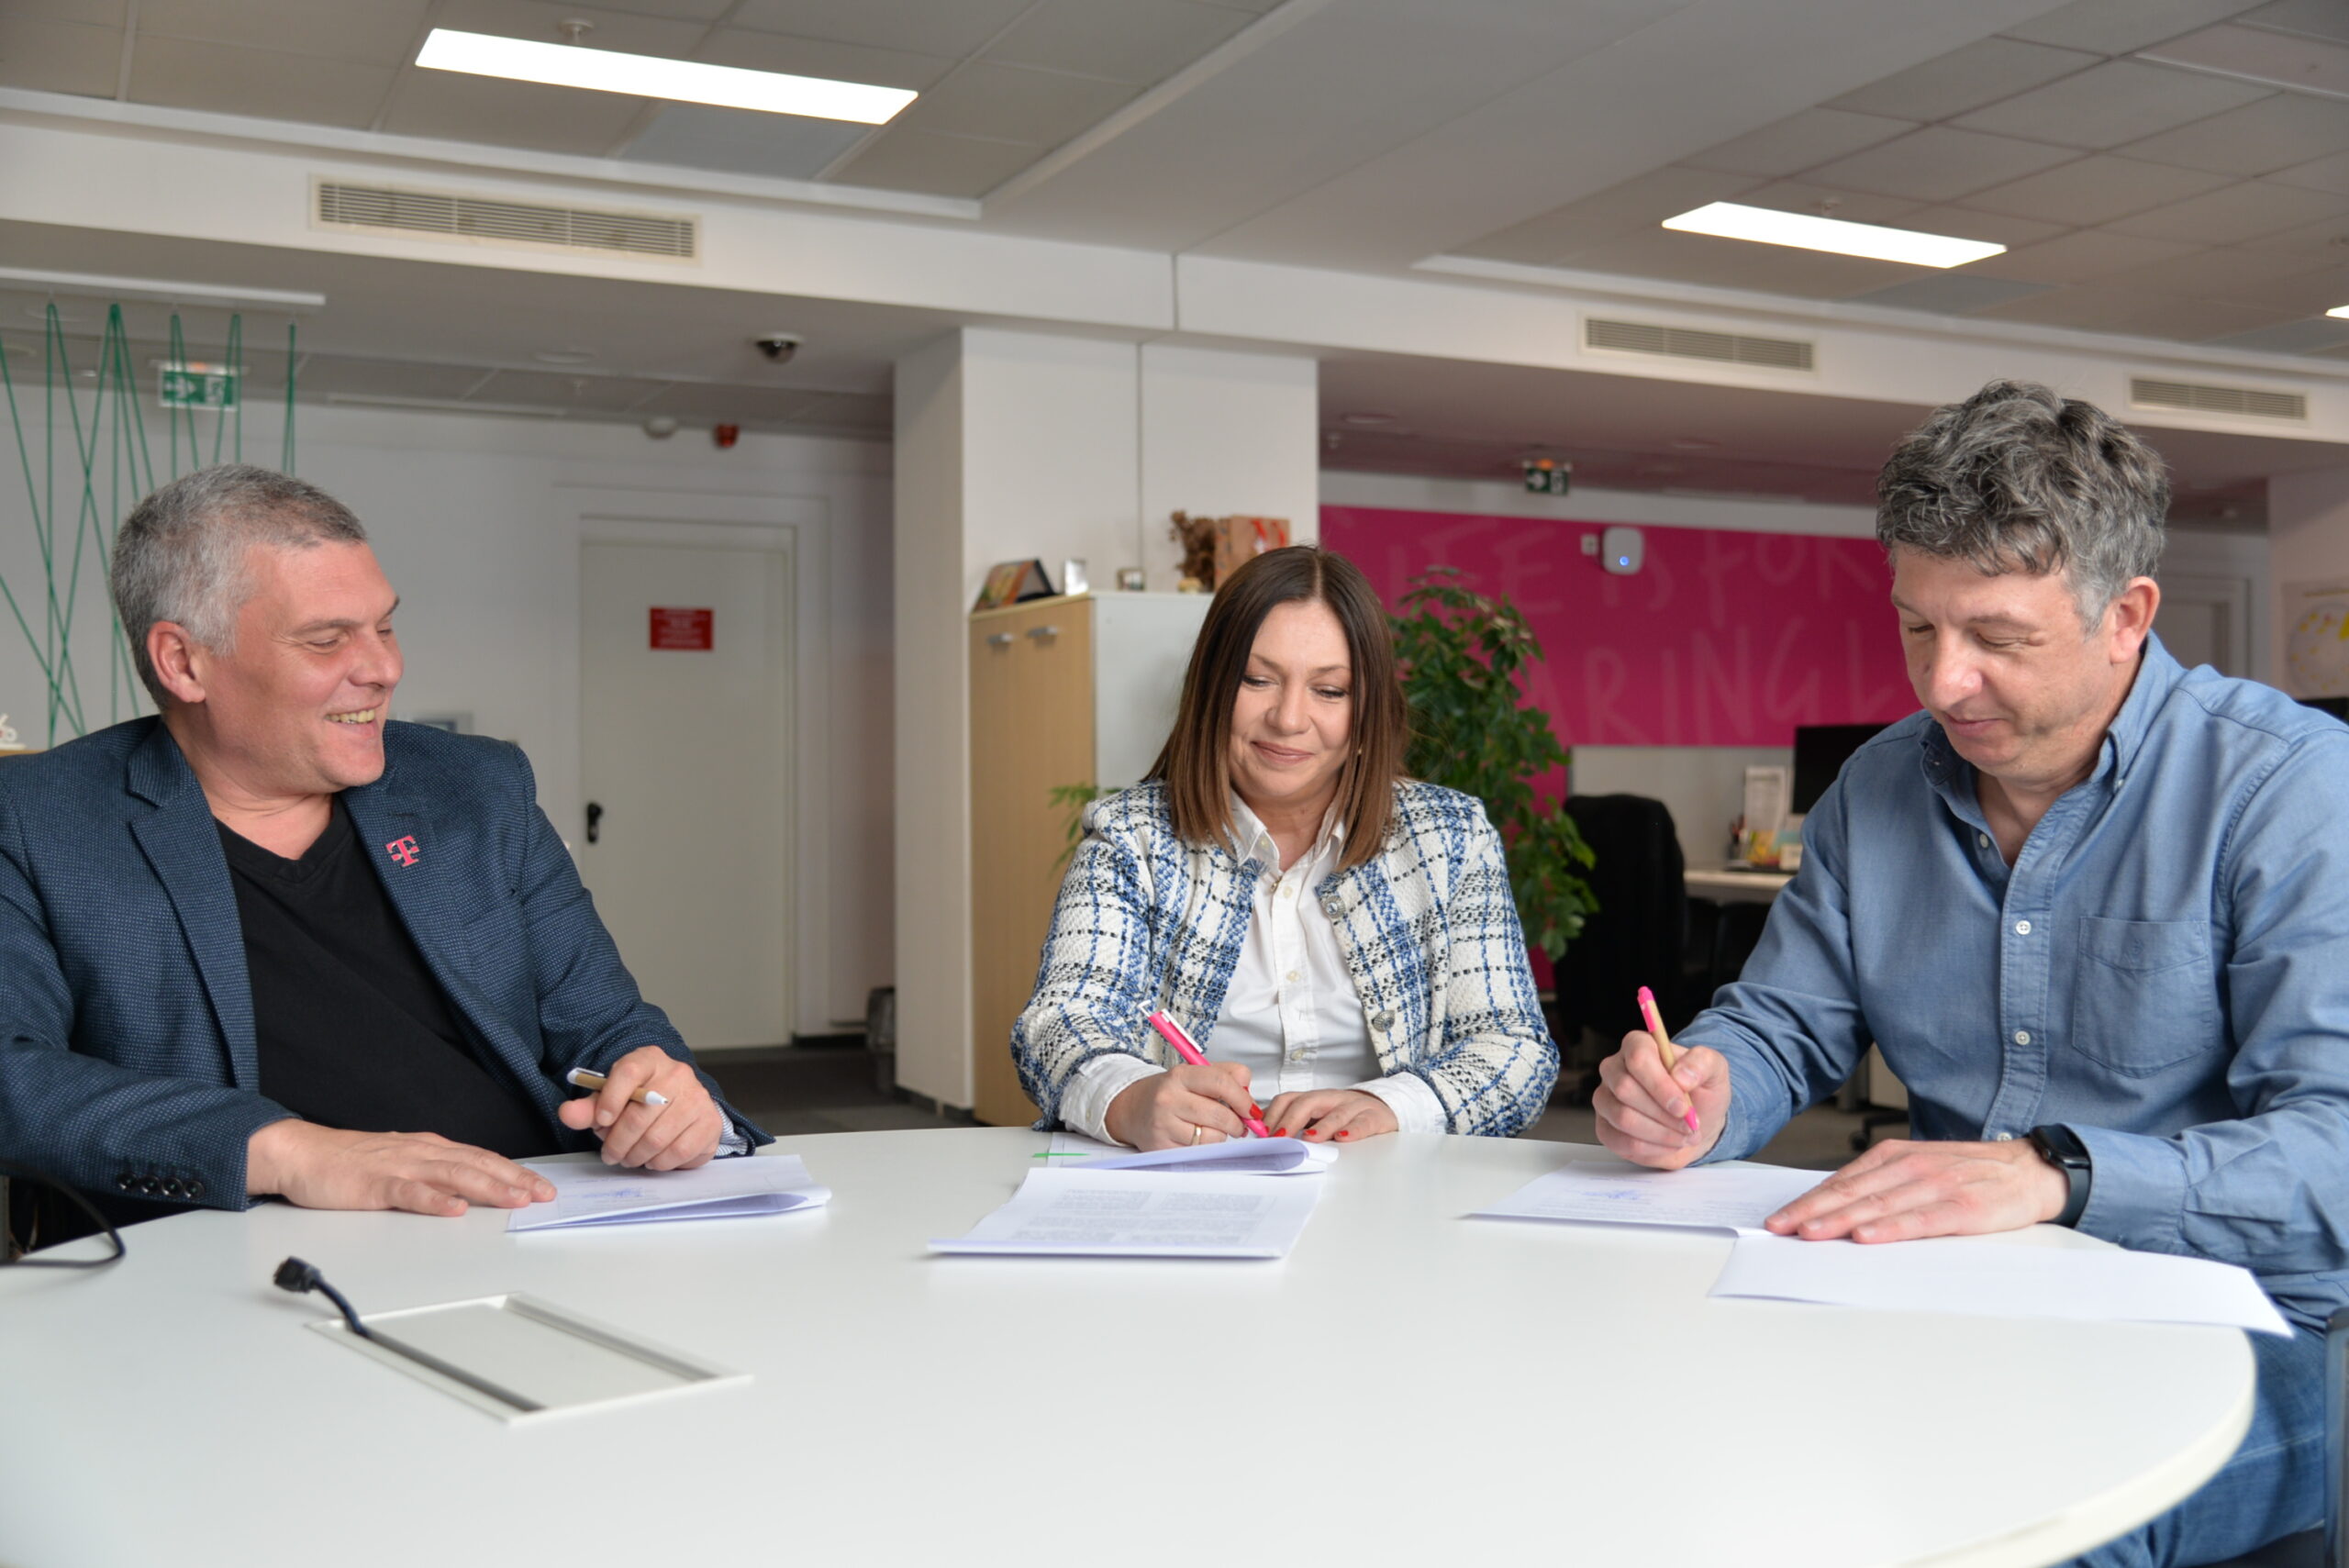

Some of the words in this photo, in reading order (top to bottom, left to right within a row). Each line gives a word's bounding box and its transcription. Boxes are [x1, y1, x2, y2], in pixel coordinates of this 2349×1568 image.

[1387, 517, 1564, 616] IFE
[1519, 616, 1821, 748] ARING
[385, 834, 419, 867] T
